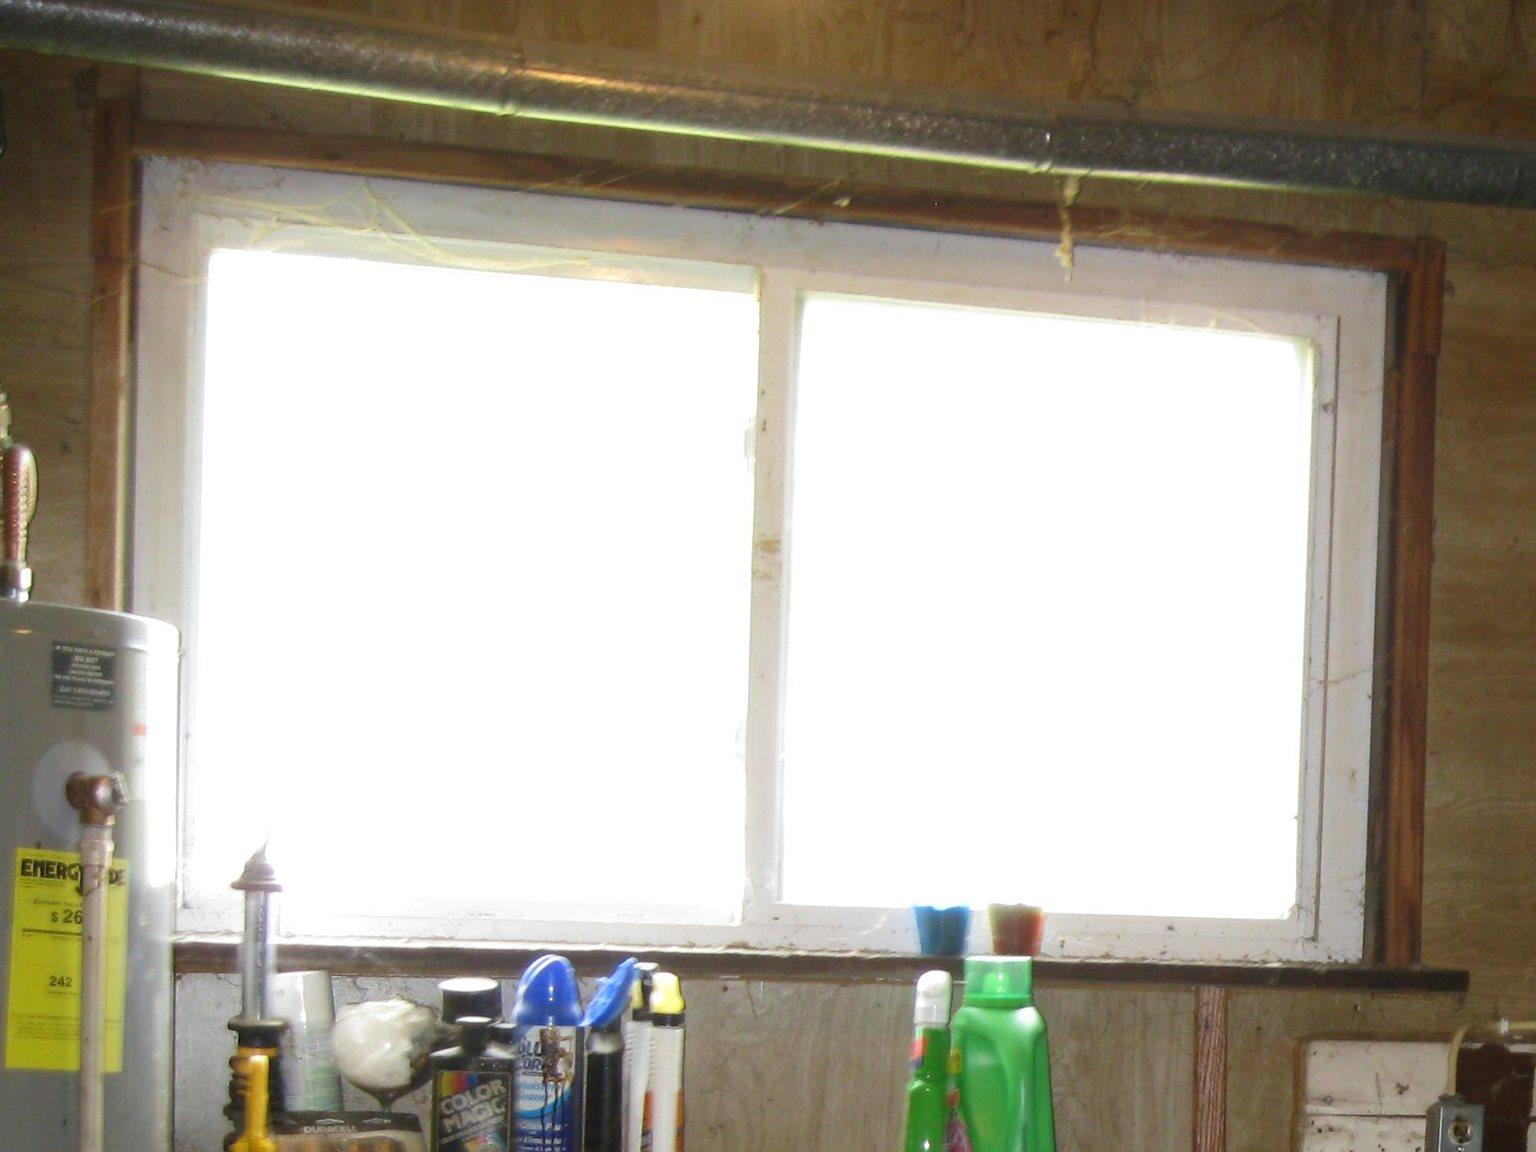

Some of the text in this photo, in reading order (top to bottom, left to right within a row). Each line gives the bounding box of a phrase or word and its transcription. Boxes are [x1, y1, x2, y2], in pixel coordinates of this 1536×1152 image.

[49, 975, 73, 988] 242
[440, 1078, 506, 1115] COLOR
[442, 1097, 507, 1135] MAGIC
